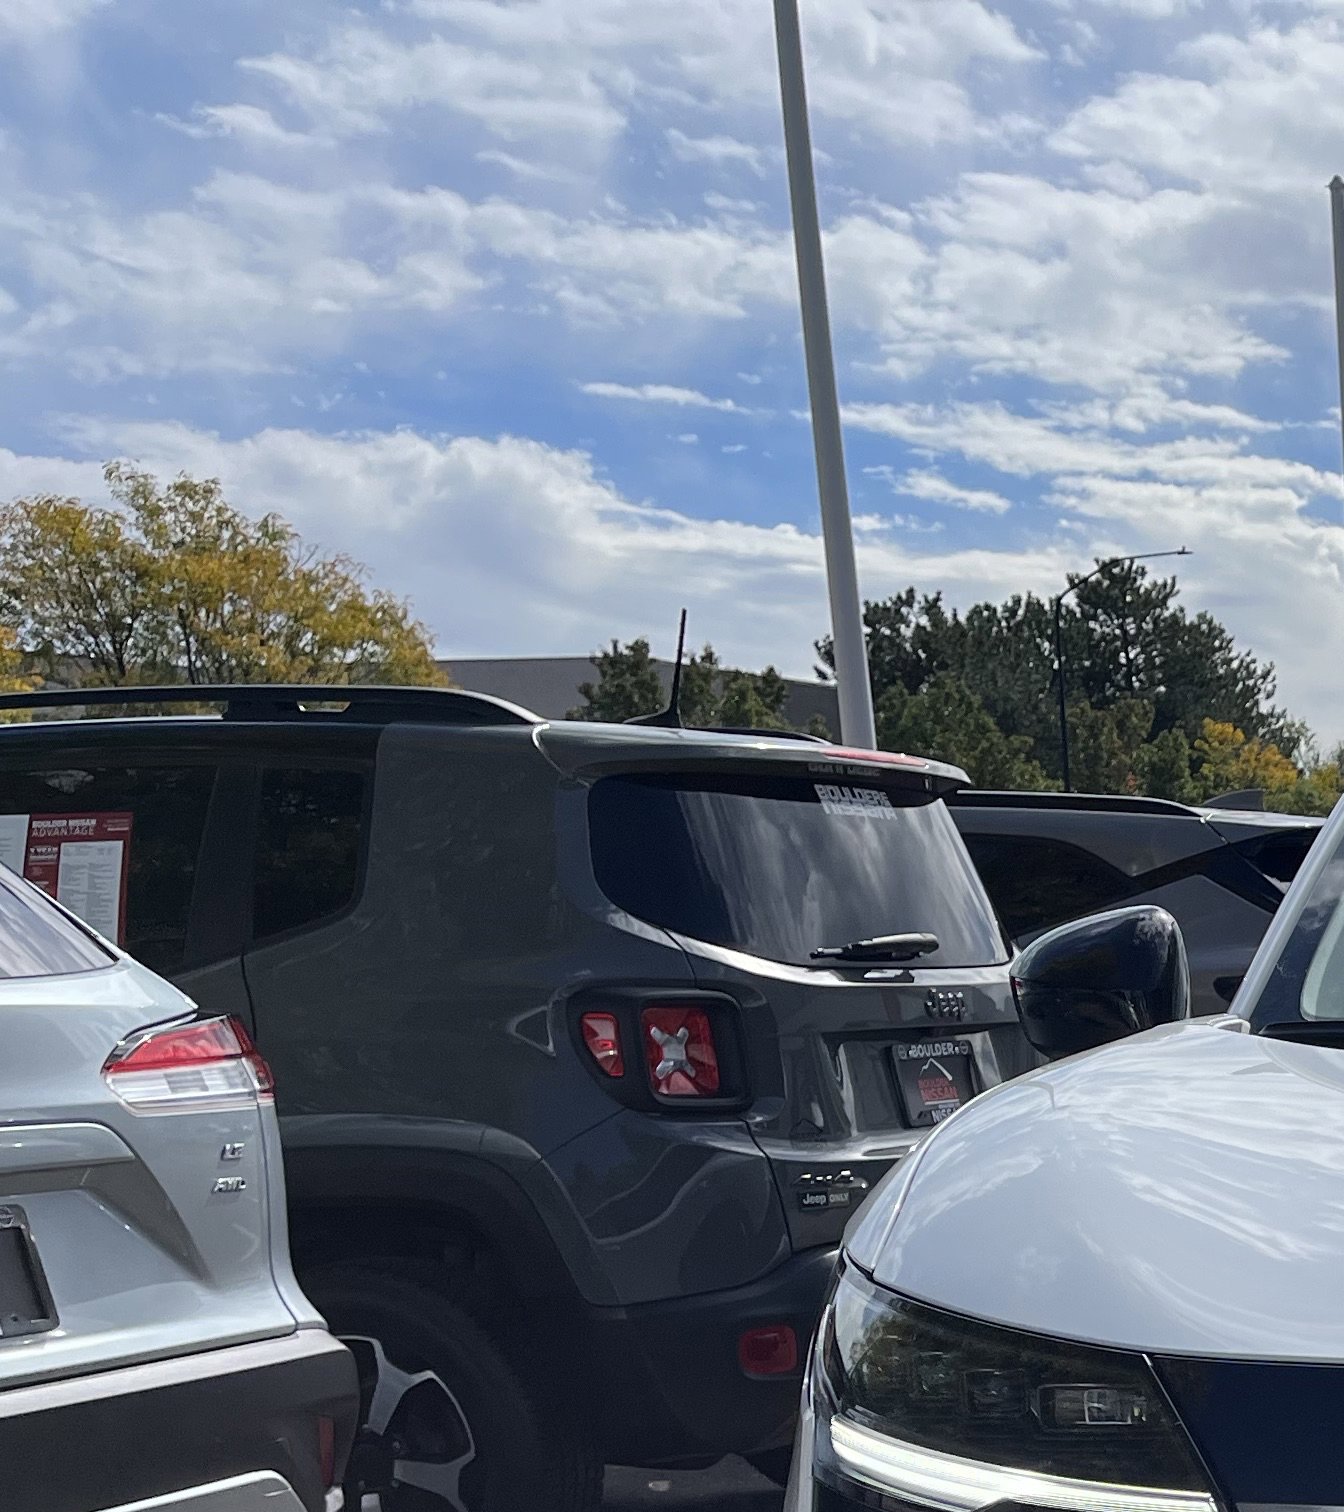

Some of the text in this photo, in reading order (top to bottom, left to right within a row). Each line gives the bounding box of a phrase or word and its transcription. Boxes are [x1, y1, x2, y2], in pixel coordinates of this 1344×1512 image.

[32, 826, 95, 837] ADVANTAGE
[911, 1042, 955, 1059] BOULDER
[921, 1085, 959, 1103] NISSAN
[802, 1193, 827, 1205] Jeep
